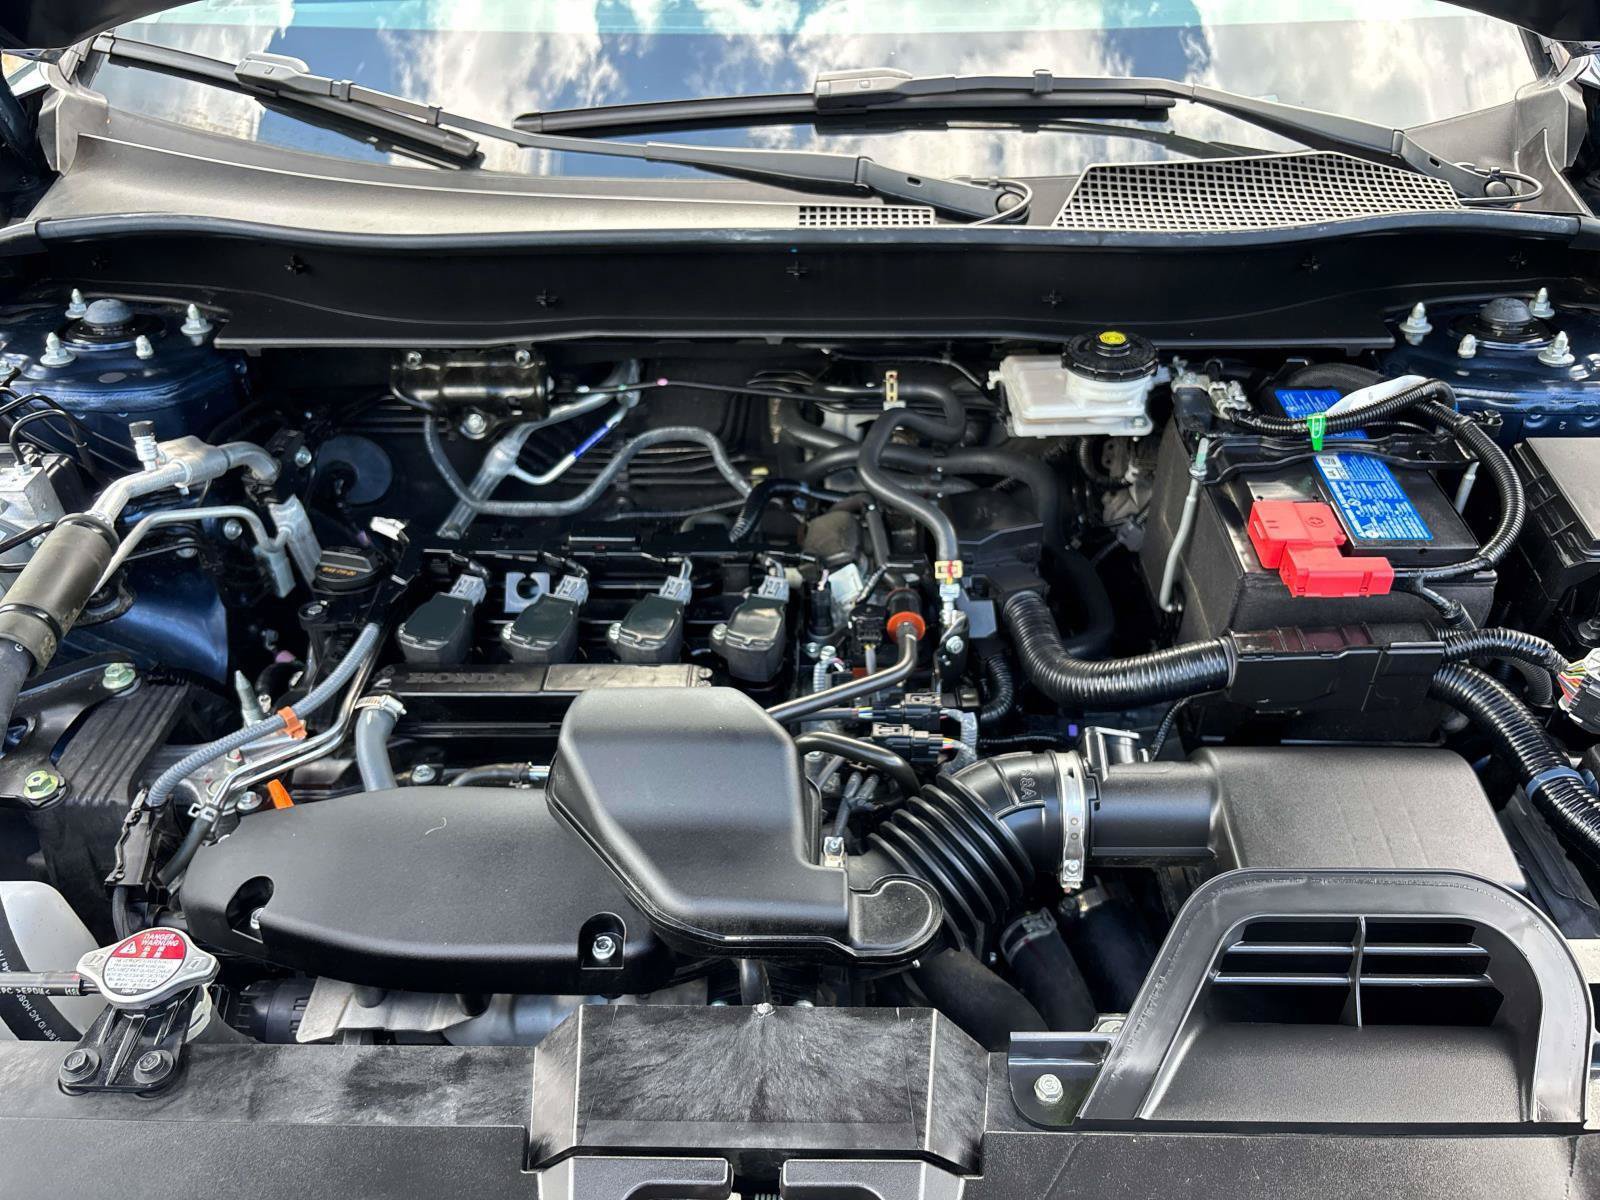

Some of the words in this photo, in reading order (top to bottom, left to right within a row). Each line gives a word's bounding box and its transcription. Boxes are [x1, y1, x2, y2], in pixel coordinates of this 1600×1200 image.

[405, 671, 525, 684] HONDA
[144, 932, 176, 941] DANGER
[38, 1022, 47, 1030] ID
